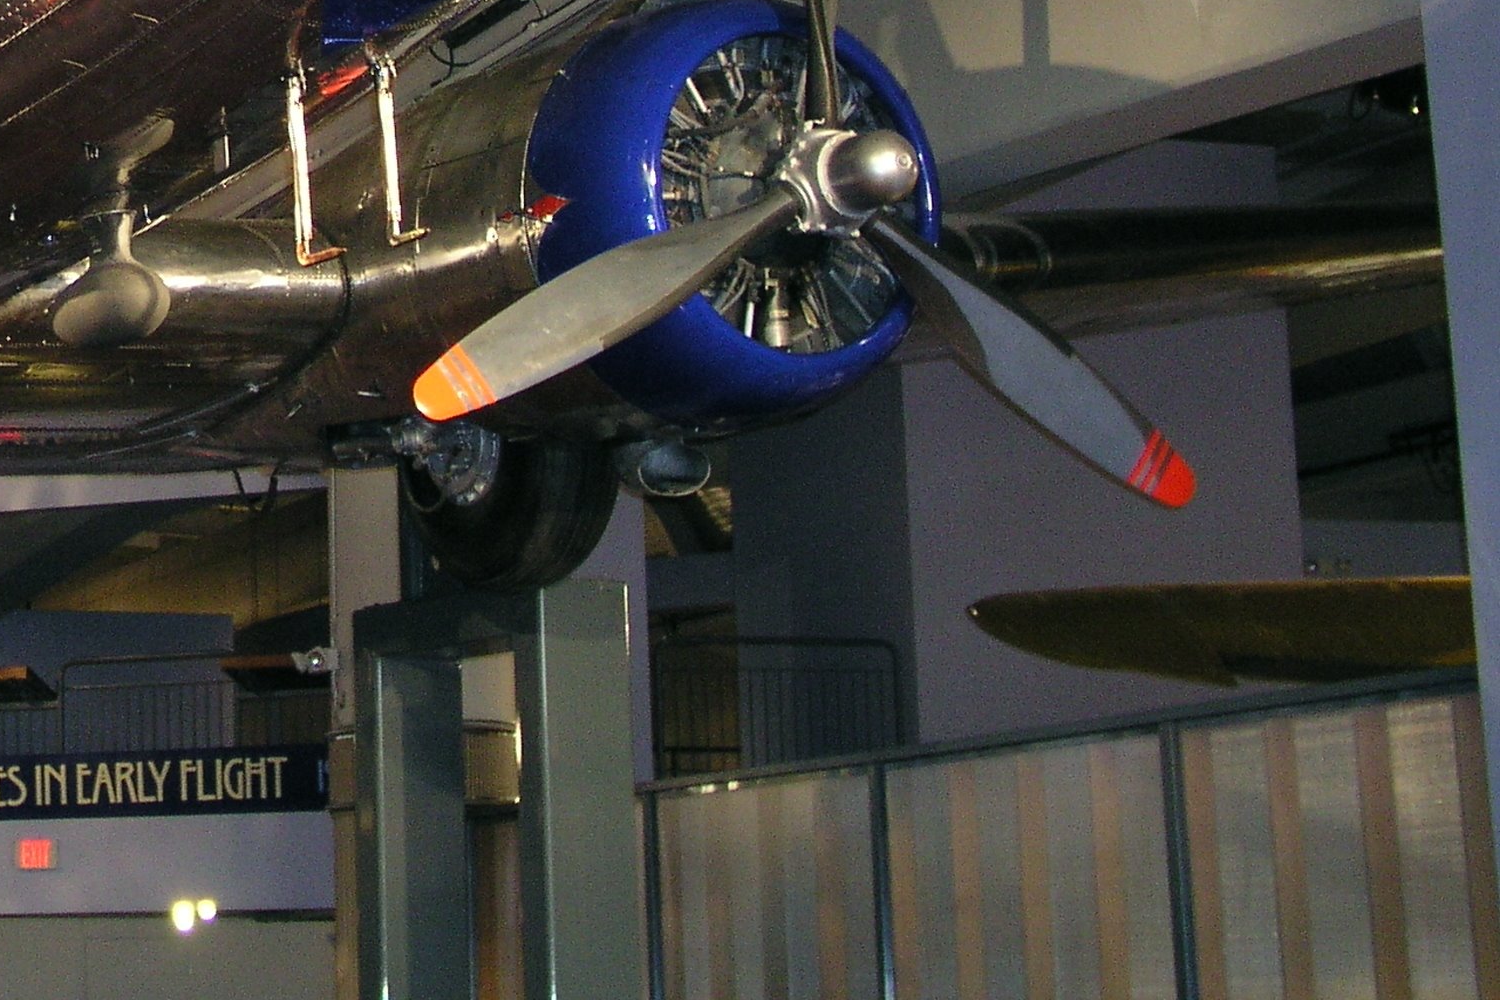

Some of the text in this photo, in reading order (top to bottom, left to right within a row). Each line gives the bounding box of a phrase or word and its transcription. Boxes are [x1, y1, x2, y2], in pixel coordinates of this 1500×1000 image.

[35, 763, 67, 805] IN
[76, 760, 171, 805] EARLY
[180, 757, 288, 801] FLIGHT
[20, 840, 49, 869] EXIT
